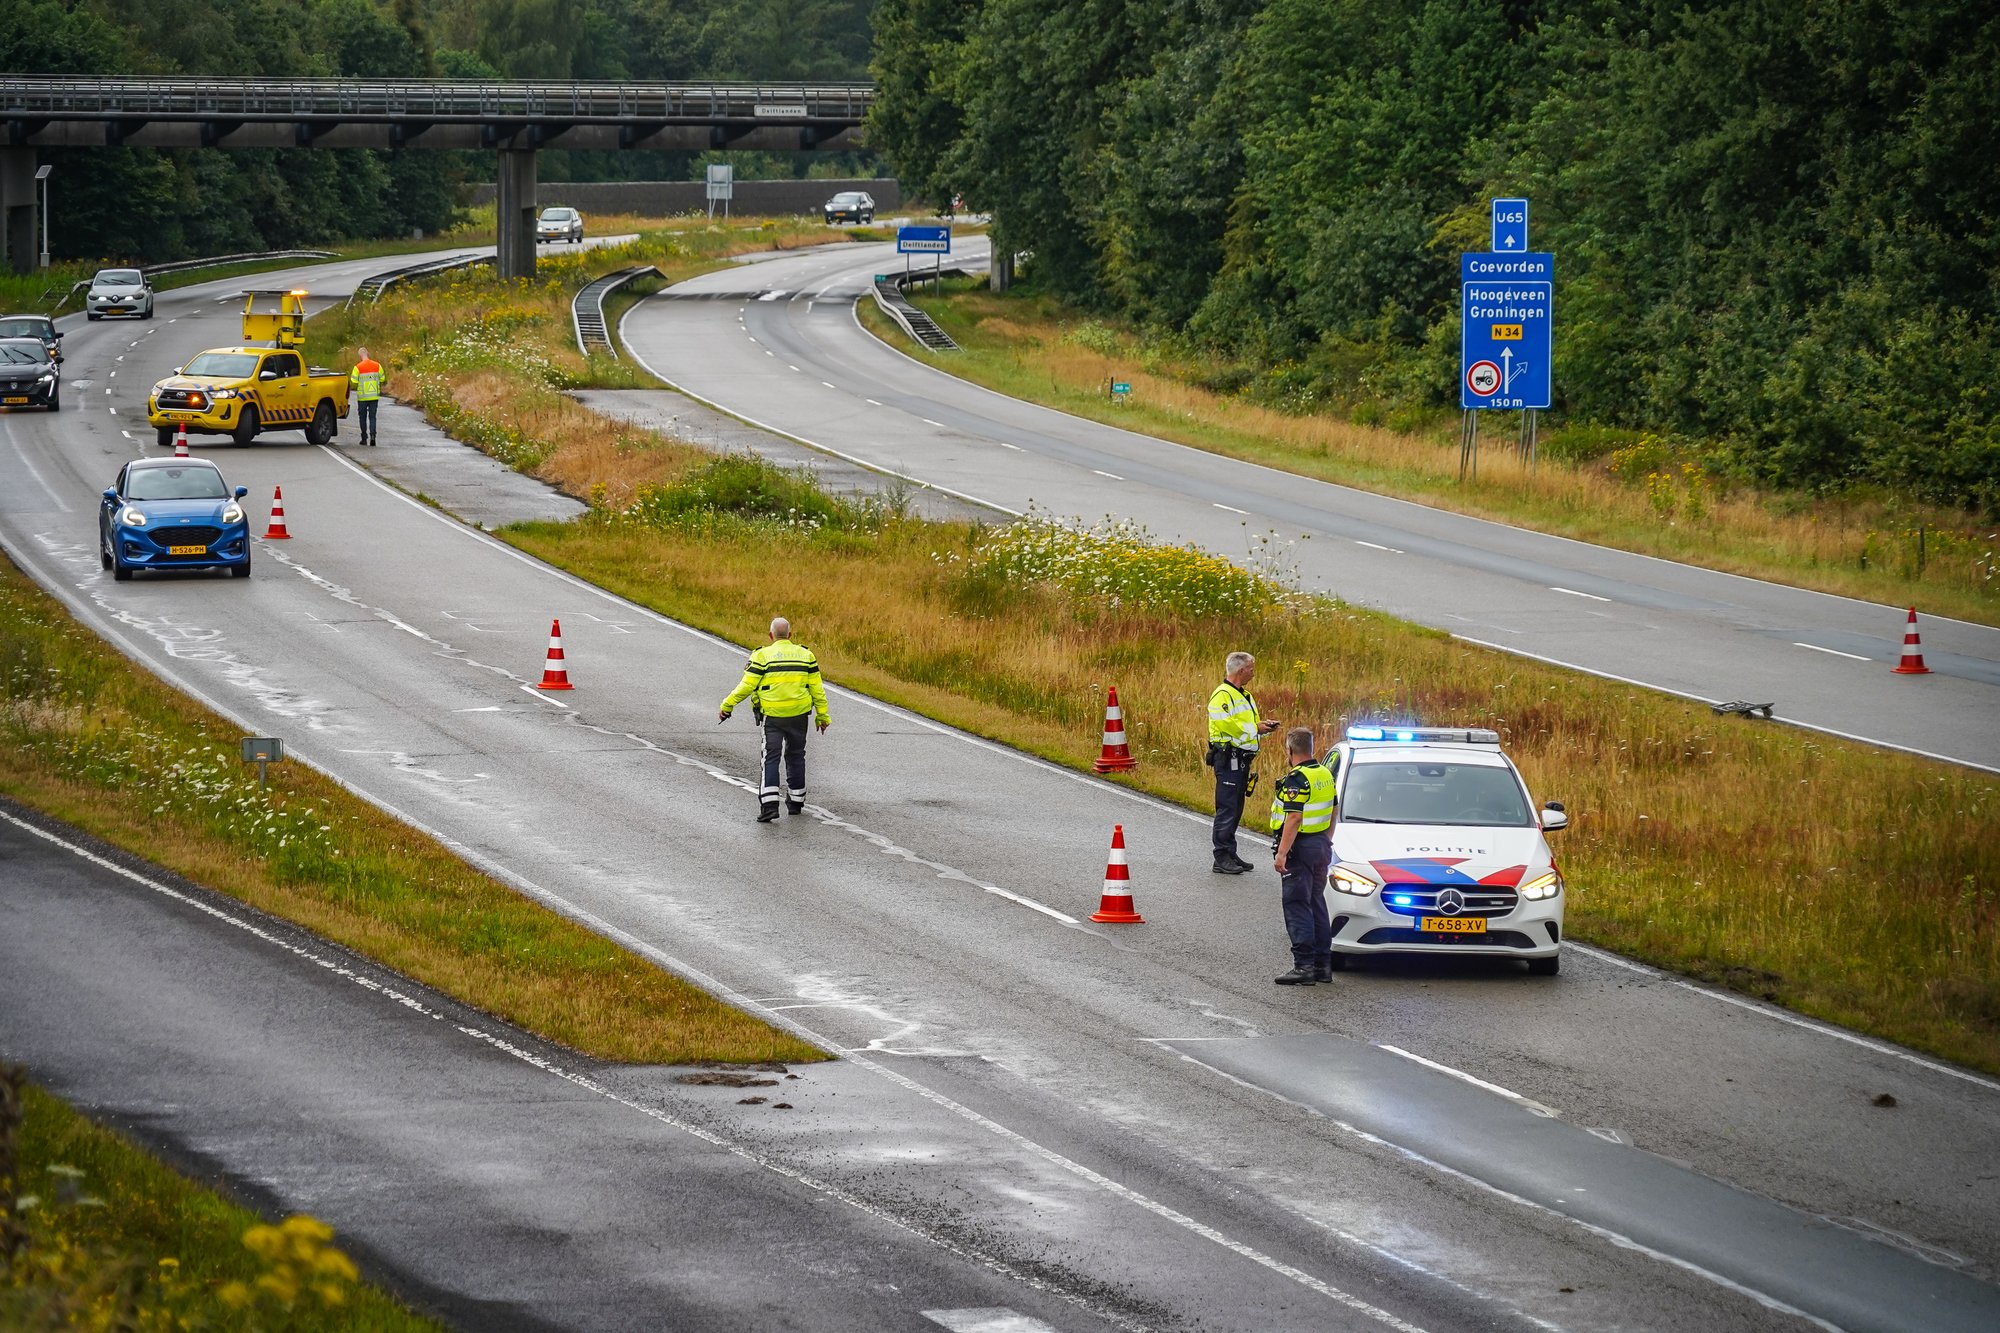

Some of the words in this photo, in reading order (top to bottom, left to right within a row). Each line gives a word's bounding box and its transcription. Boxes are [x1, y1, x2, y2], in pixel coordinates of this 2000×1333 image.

[1496, 212, 1524, 223] U65
[1469, 261, 1544, 273] Coevorden
[1470, 288, 1545, 304] Hoogeveen
[1470, 306, 1544, 321] Groningen
[1494, 327, 1502, 336] N
[1505, 327, 1520, 336] 34
[1490, 398, 1510, 407] 150
[1512, 399, 1523, 407] m
[171, 546, 205, 554] H-526-PH
[1406, 846, 1487, 855] POLITIE
[1426, 918, 1483, 931] T-658-XV
